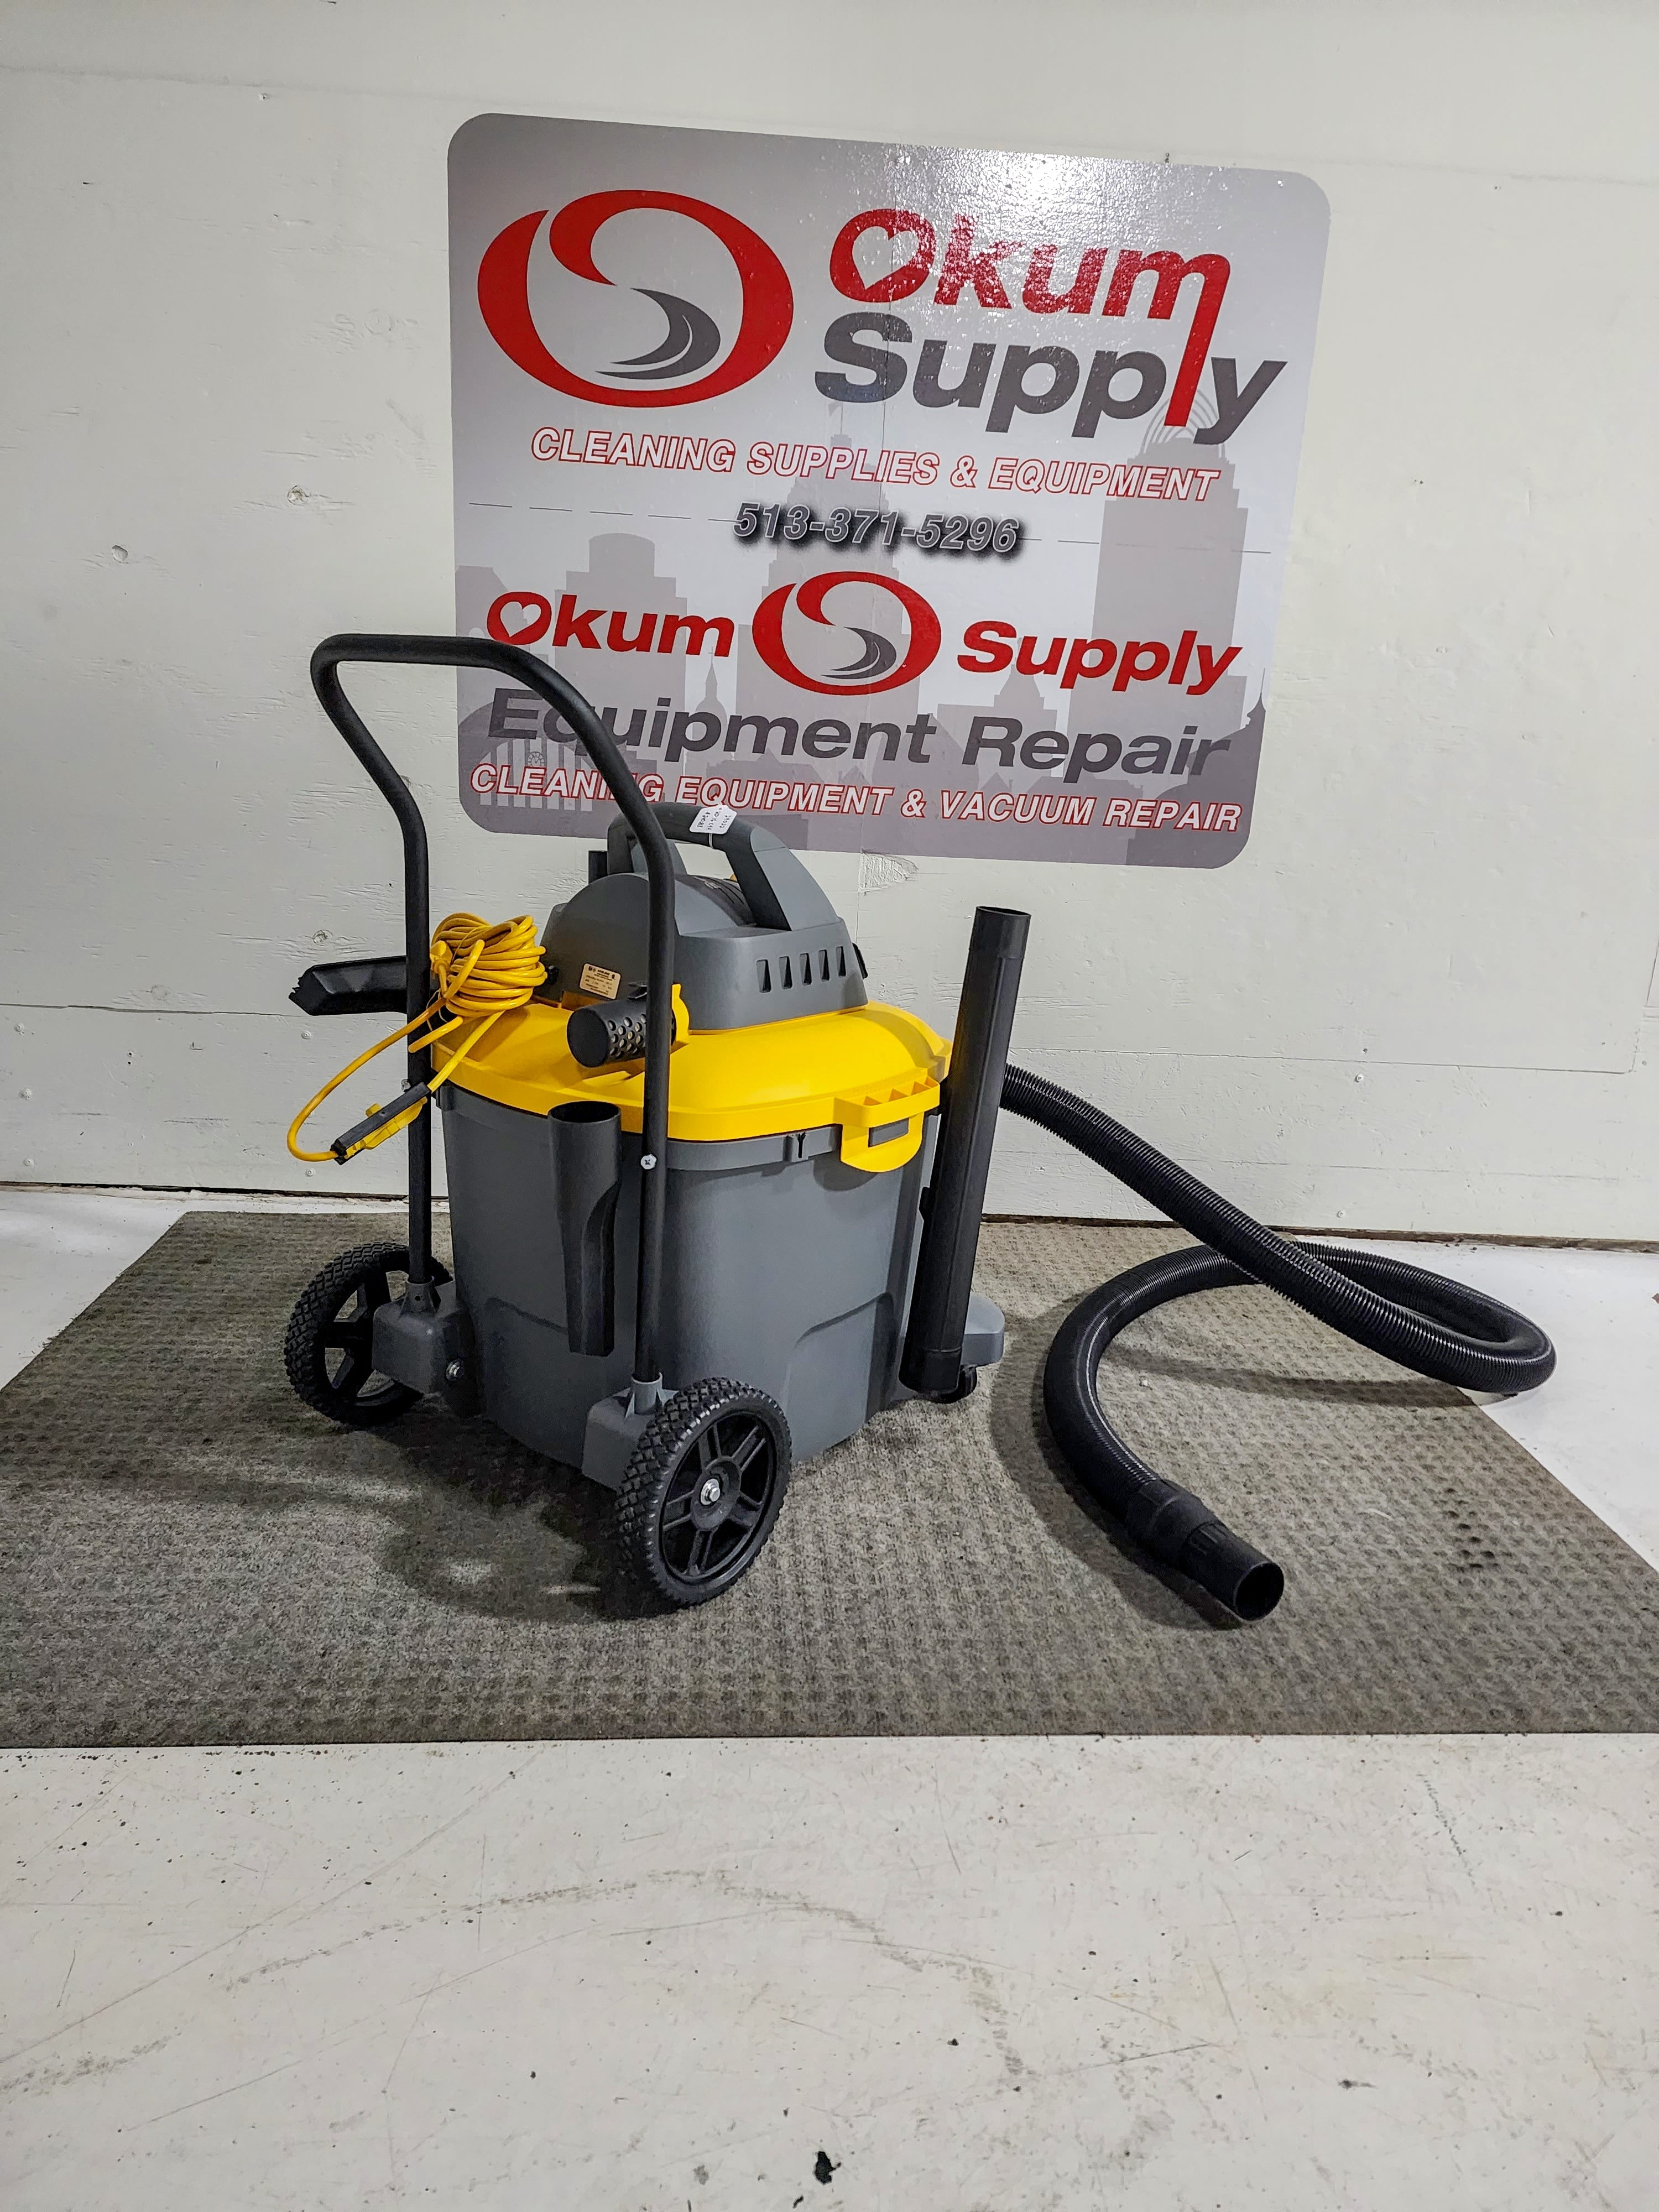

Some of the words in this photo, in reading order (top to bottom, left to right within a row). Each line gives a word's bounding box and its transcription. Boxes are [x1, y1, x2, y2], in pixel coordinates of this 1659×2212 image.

[829, 208, 1231, 332] Okum
[814, 311, 1288, 446] Supply
[531, 426, 736, 473] CLEANING
[747, 441, 941, 485] SUPPLIES
[950, 455, 978, 488] &
[988, 457, 1222, 502] EQUIPMENT
[733, 502, 1020, 552] 513-371-5296
[486, 591, 735, 658] Okum
[956, 620, 1243, 696] Supply
[488, 687, 938, 764] Equipment
[961, 716, 1231, 784] Repair
[469, 763, 665, 803] CLEANIG
[675, 776, 895, 816] EQUIPMENT
[901, 789, 927, 818] &
[941, 790, 1097, 826] VACUUM
[1103, 797, 1243, 832] REPAIR
